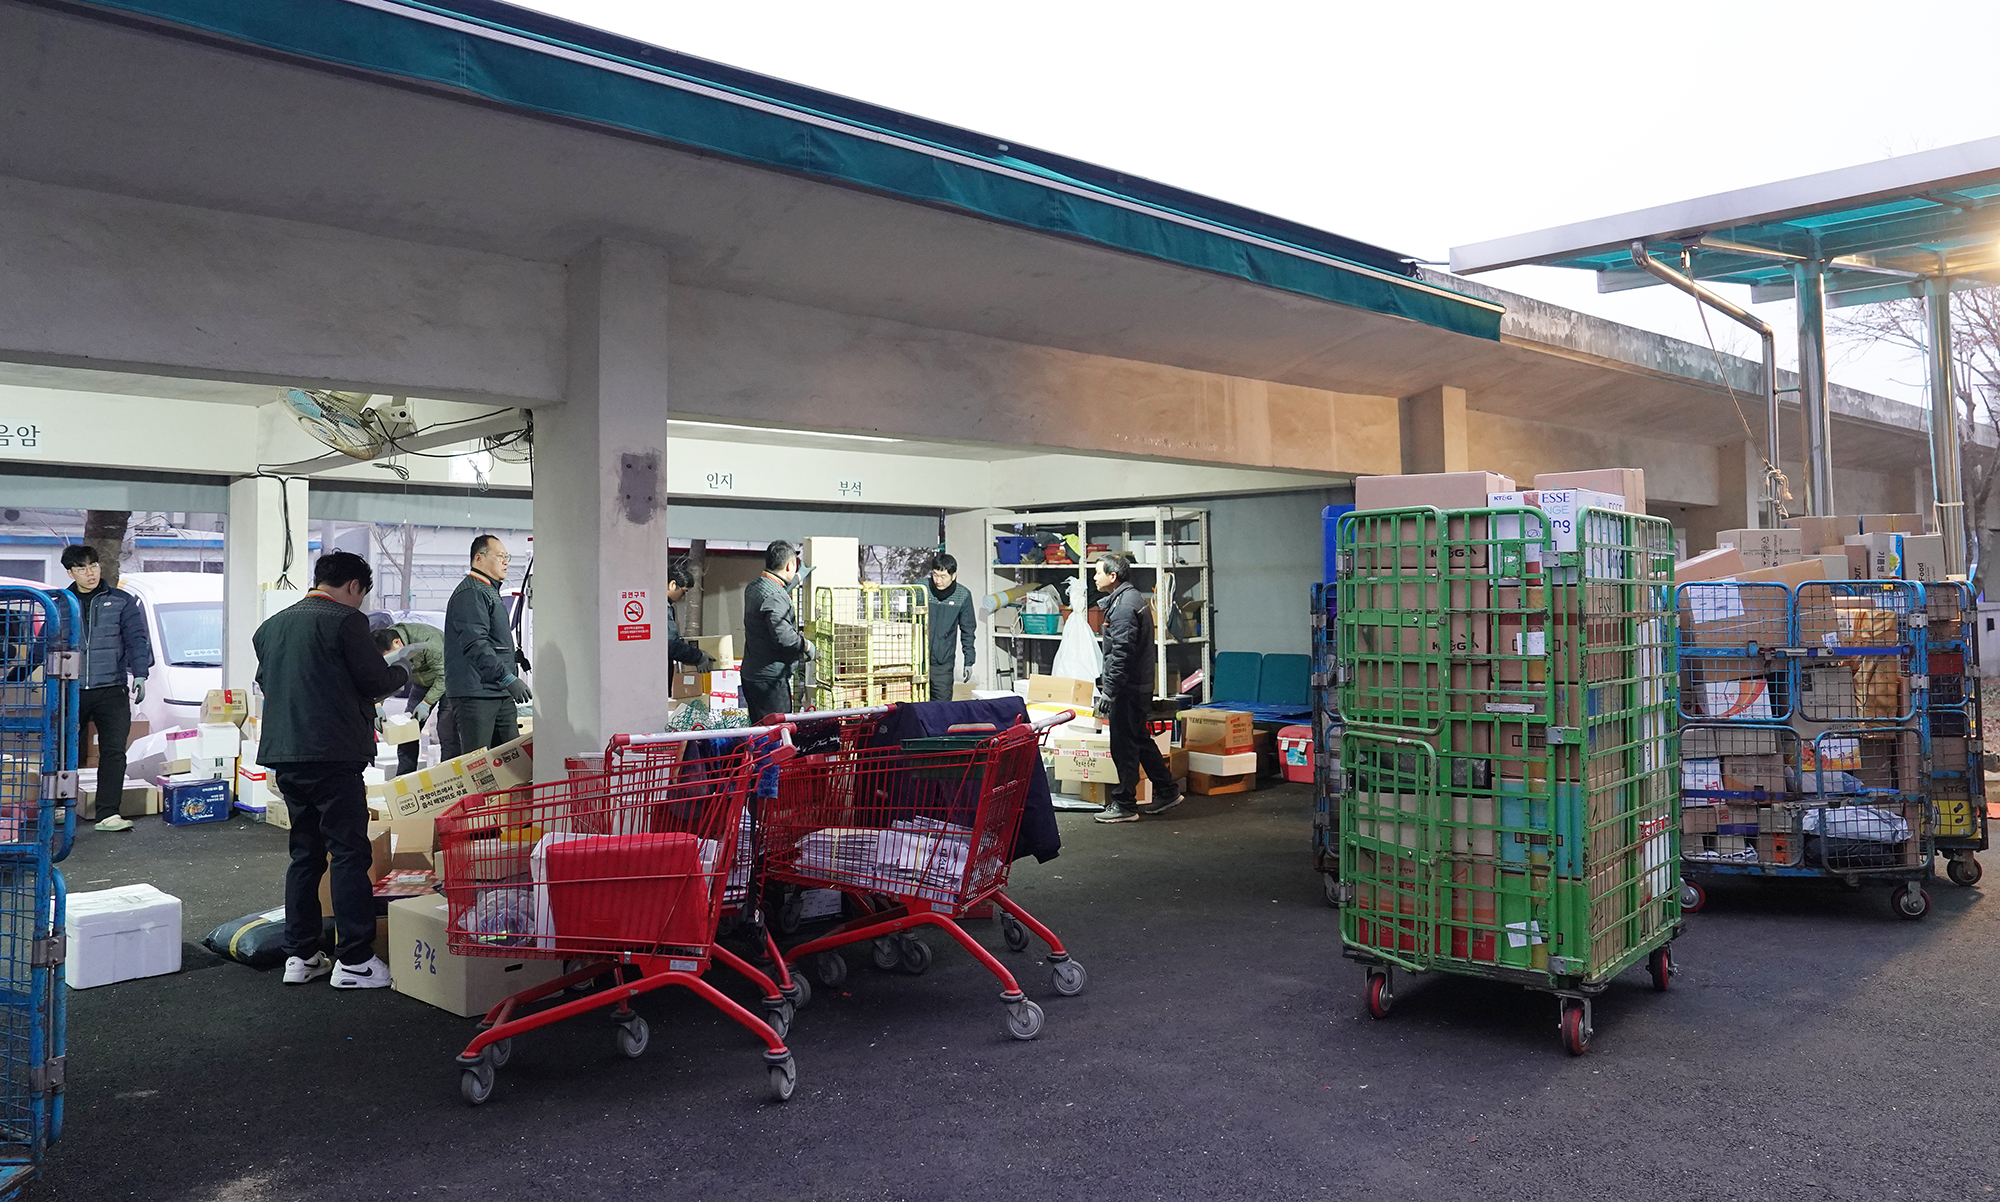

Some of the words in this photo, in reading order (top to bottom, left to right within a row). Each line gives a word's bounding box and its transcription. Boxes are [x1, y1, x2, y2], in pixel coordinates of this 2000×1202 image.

[0, 424, 41, 447] 음암
[706, 472, 733, 490] 인지
[838, 480, 862, 497] 부석
[1541, 492, 1571, 504] ESSE
[1430, 548, 1465, 558] K&G
[1917, 562, 1925, 581] Food
[621, 591, 646, 599] 금연구역
[1432, 640, 1467, 651] K&G
[419, 785, 453, 801] 쿠팡이츠에서
[456, 788, 468, 797] 무료
[400, 801, 416, 811] eats
